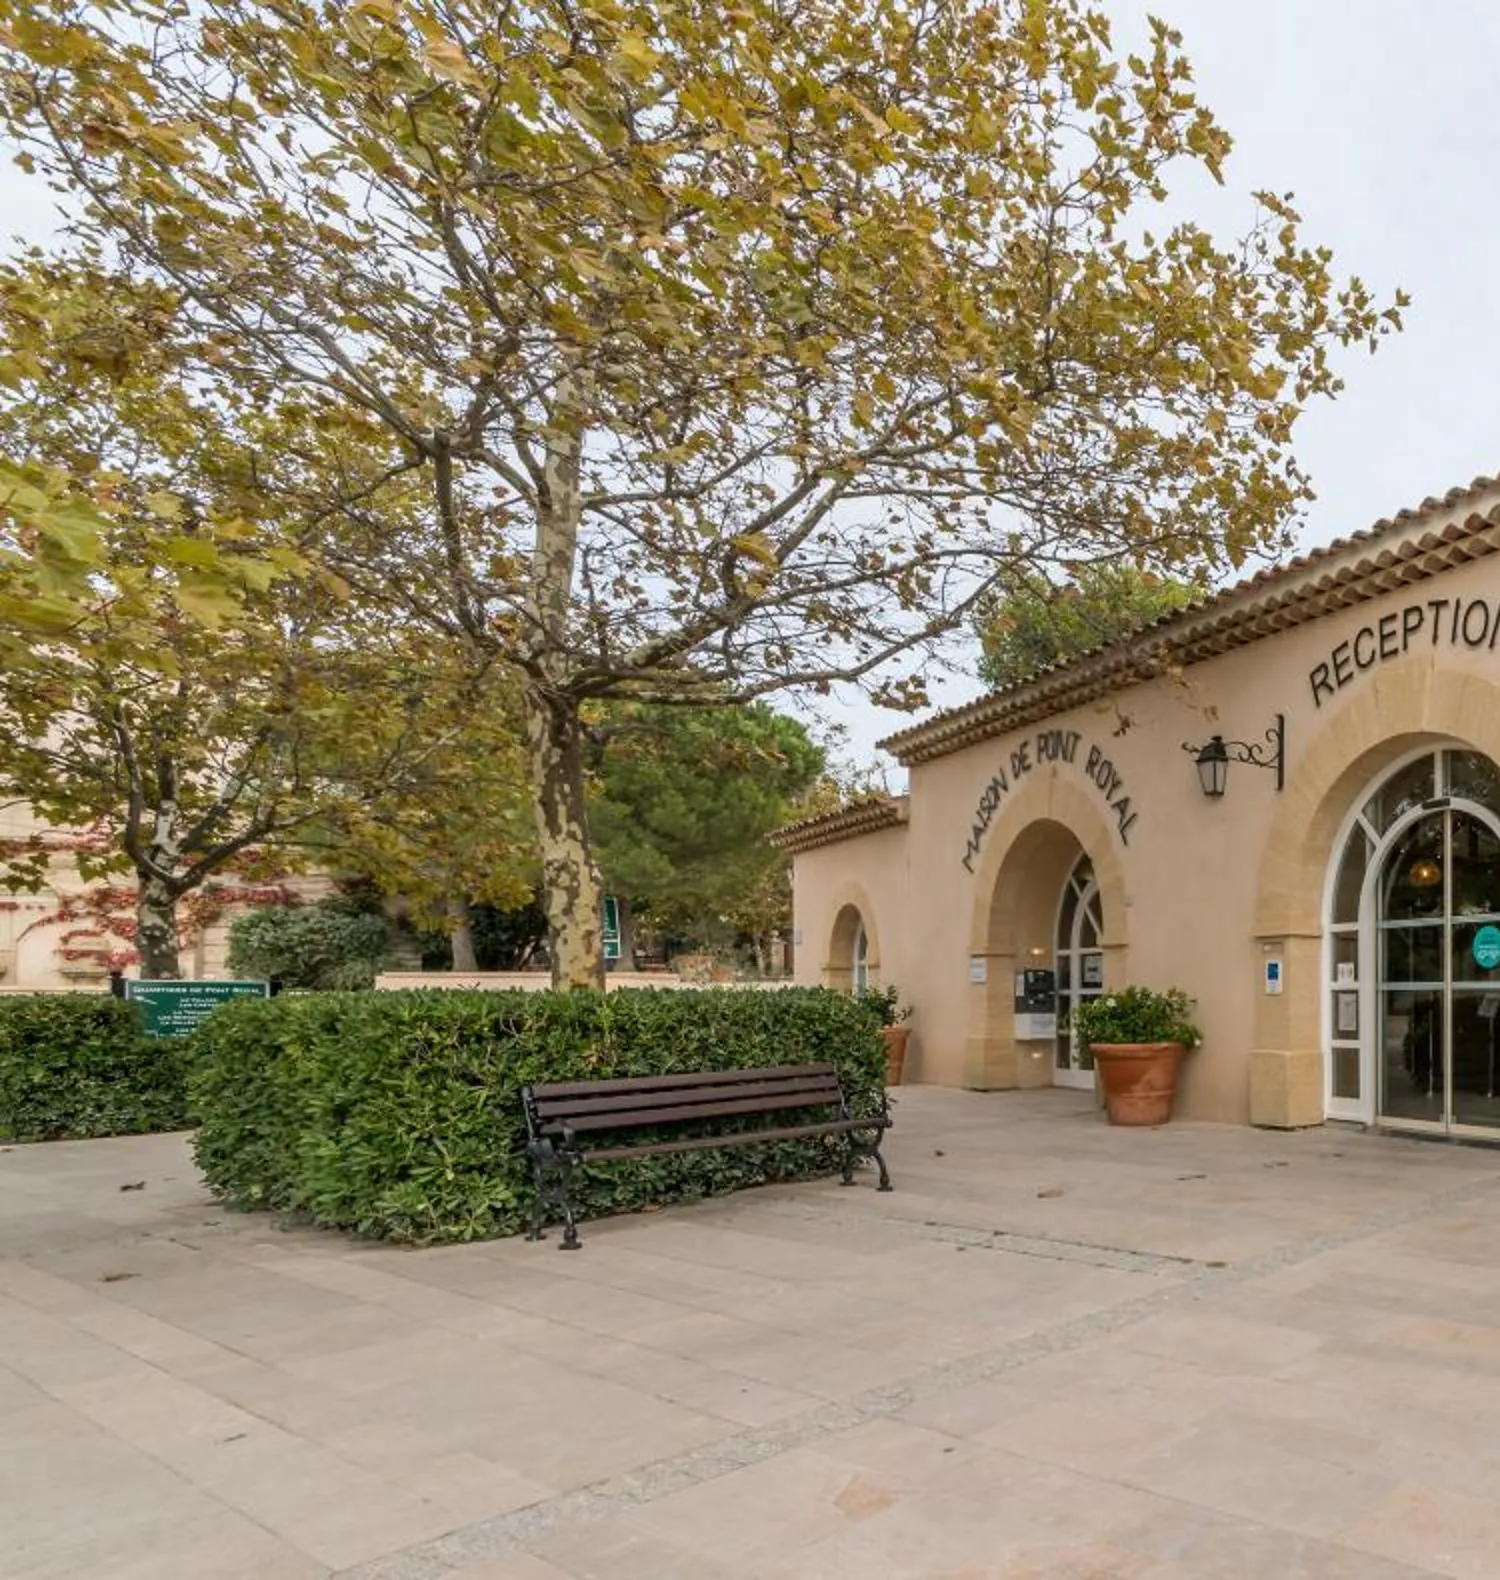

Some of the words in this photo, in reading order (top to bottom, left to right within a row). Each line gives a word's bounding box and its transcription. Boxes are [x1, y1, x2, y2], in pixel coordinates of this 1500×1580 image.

[961, 767, 1009, 874] MAISON
[1010, 740, 1032, 781] DE
[1036, 729, 1083, 765] PONT
[1085, 744, 1139, 847] ROYAL
